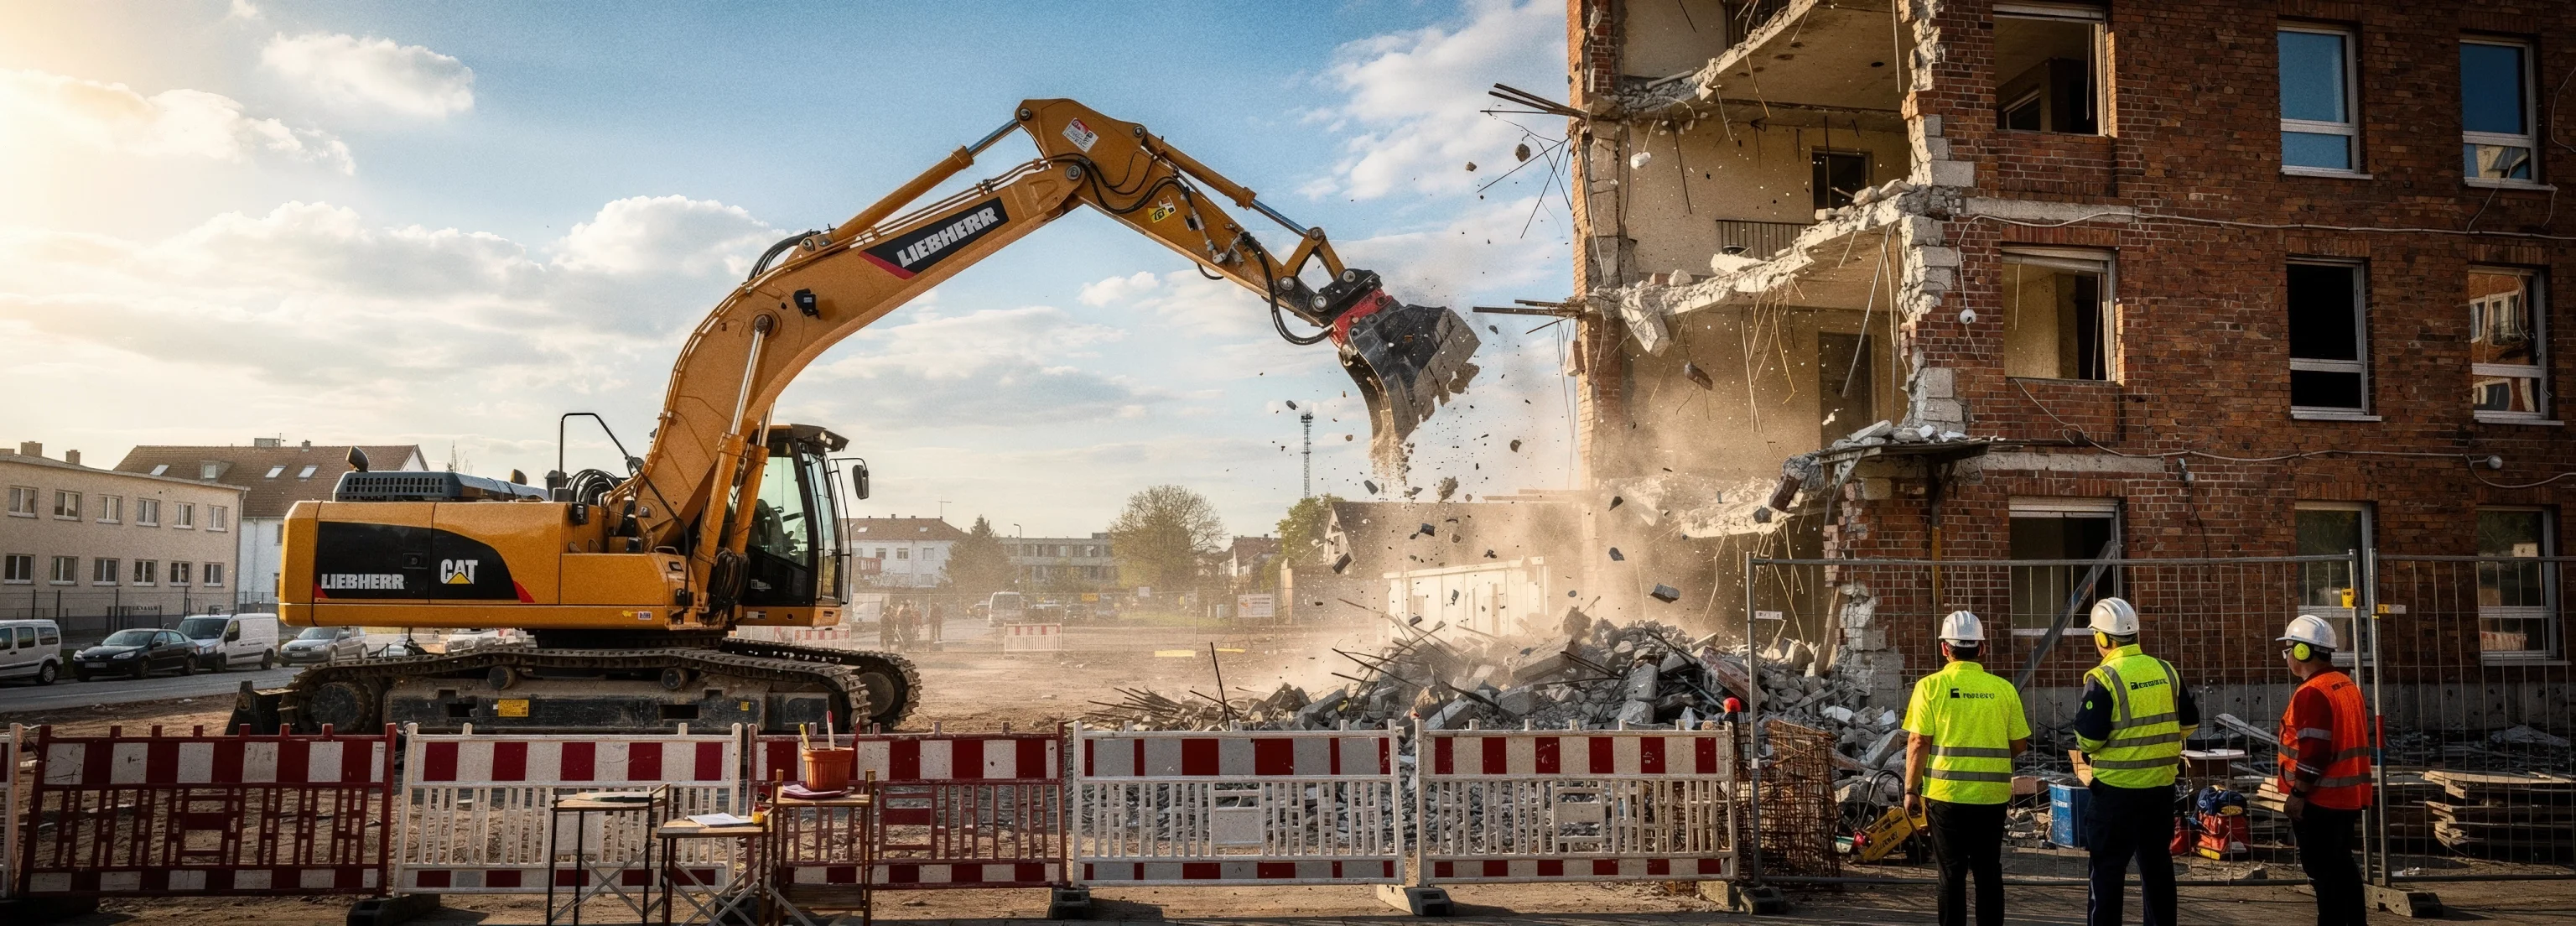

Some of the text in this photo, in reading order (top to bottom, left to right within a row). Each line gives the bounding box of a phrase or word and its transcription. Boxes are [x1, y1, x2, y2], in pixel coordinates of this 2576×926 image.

[896, 206, 999, 268] LIEBHERR
[321, 573, 405, 590] LIEBHERR
[440, 559, 479, 585] CAT
